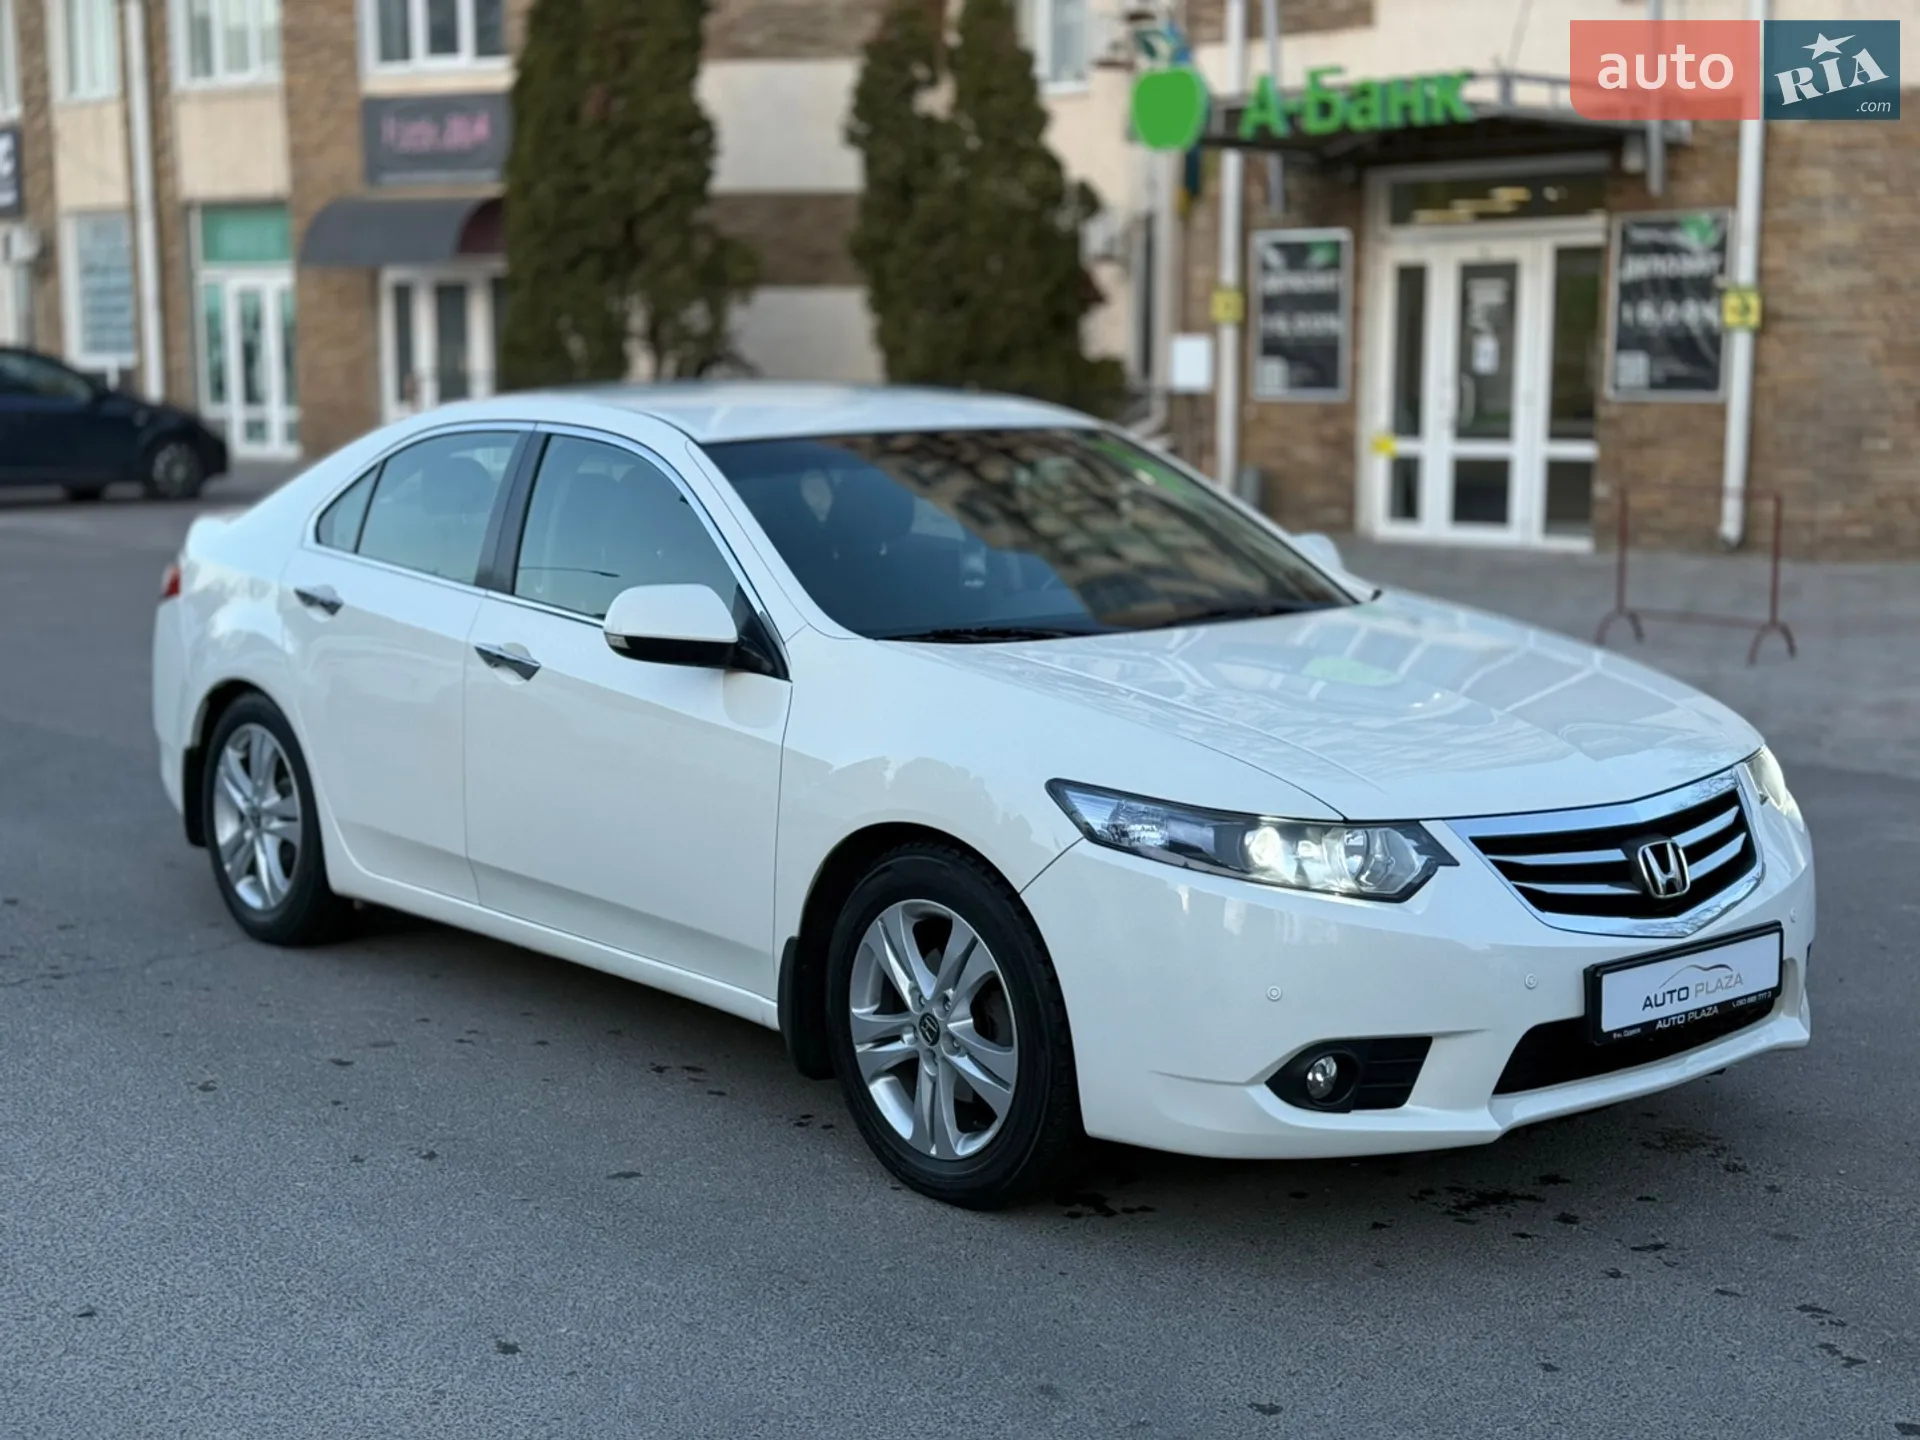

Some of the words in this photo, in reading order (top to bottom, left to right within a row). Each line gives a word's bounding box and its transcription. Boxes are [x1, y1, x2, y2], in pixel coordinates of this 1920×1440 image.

[1236, 65, 1474, 140] А-Банк
[1642, 986, 1690, 1011] AUTO
[1694, 972, 1744, 998] PLAZA
[1655, 1014, 1686, 1030] AUTO
[1687, 1005, 1719, 1022] PLAZA
